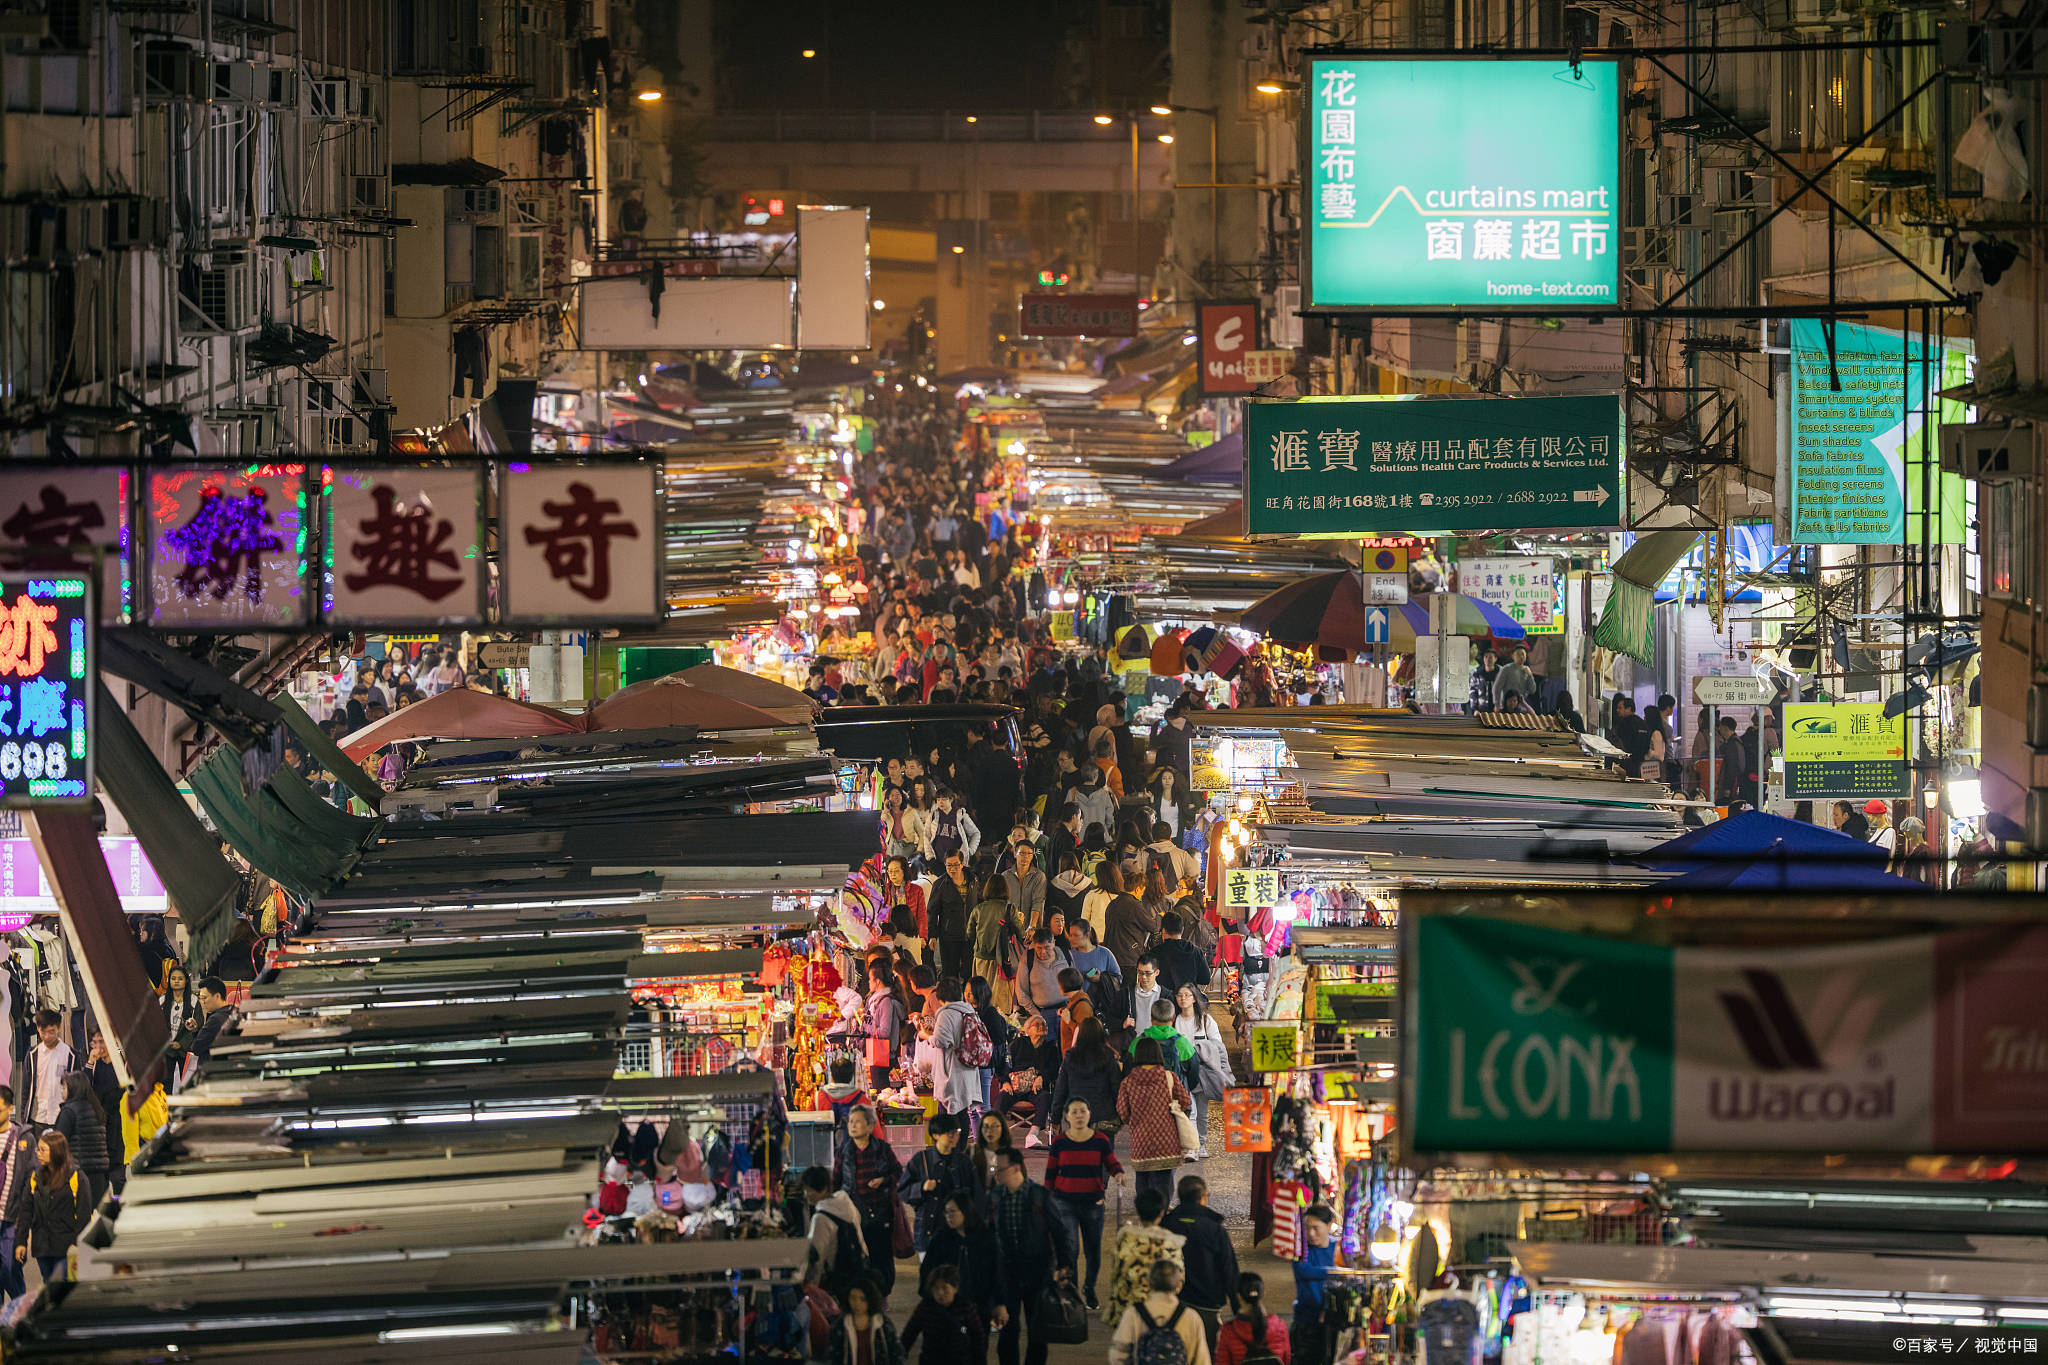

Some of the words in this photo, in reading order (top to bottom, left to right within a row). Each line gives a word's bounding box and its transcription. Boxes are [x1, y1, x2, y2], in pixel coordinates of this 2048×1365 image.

[1320, 70, 1356, 218] 花園布藝
[1425, 185, 1537, 208] curtains
[1543, 185, 1610, 208] mart
[1425, 218, 1610, 261] 窗簾超市
[1487, 280, 1610, 296] home-text.com
[1208, 360, 1245, 379] Hai
[1844, 379, 1880, 393] safety
[1882, 379, 1905, 389] nets
[1798, 394, 1863, 404] Smarthome
[1798, 407, 1845, 418] Curtains
[1848, 408, 1857, 418] &
[1859, 407, 1894, 418] blinds
[1798, 422, 1830, 433] Insect
[1832, 424, 1874, 433] screens
[1798, 436, 1820, 447] Sun
[1822, 435, 1862, 447] shades
[1270, 427, 1361, 473] 滙寶
[1371, 435, 1609, 463] 醫療用品配套有限公司
[1798, 450, 1823, 461] Sofa
[1826, 450, 1864, 461] fabrics
[1369, 463, 1419, 473] Solutions
[1421, 461, 1455, 472] Health
[1457, 462, 1481, 470] Care
[1484, 460, 1529, 470] Products
[1531, 460, 1541, 468] &
[1543, 458, 1586, 468] Services
[1588, 458, 1609, 467] Ltd.
[1798, 464, 1853, 475] Insulation
[1855, 464, 1884, 475] films
[1798, 479, 1839, 492] Folding
[1841, 480, 1884, 489] screens
[1266, 493, 1414, 510] 旺角花園街168號1樓
[1435, 495, 1460, 508] 2395
[1463, 494, 1494, 507] 2922
[1507, 490, 1535, 503] 2688
[1538, 492, 1569, 505] 2922
[1798, 493, 1839, 504] Interior
[1841, 493, 1885, 504] finishes
[1798, 507, 1831, 518] Fabric
[1833, 507, 1888, 521] partitions
[1798, 522, 1822, 533] Soft
[1824, 522, 1851, 533] cells
[1852, 521, 1890, 533] fabrics
[1375, 576, 1396, 586] End
[1531, 573, 1549, 586] 工程
[1371, 589, 1399, 601] 終止
[1482, 588, 1511, 600] Beauty
[1515, 588, 1549, 599] Curtain
[496, 645, 514, 653] Bute
[1713, 680, 1732, 688] Bute
[1734, 680, 1759, 688] Street
[1228, 872, 1277, 905] 童裝
[1707, 1074, 1897, 1122] Wacoal
